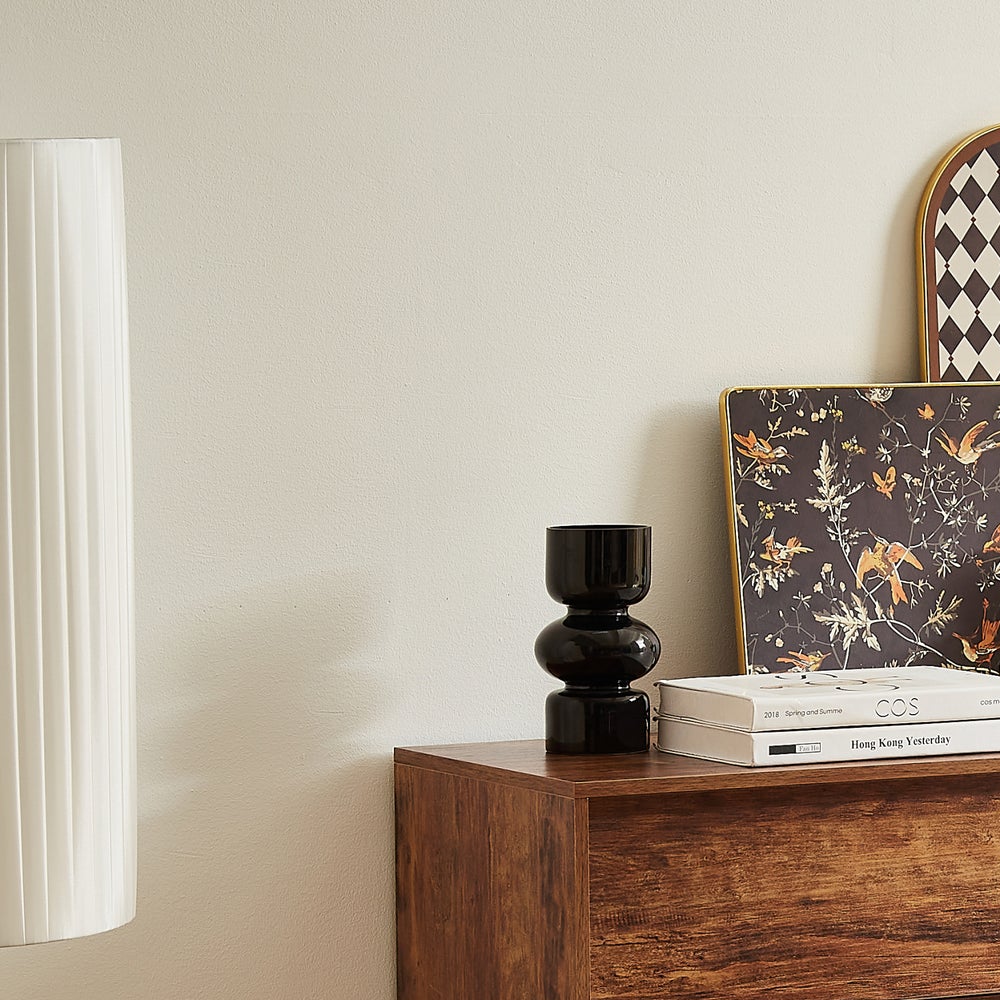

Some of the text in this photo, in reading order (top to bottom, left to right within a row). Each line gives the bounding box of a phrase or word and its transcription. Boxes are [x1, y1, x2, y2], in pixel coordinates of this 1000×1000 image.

[764, 711, 780, 719] 2018
[875, 698, 920, 718] COS
[851, 735, 951, 750] Hong Kong Yesterday
